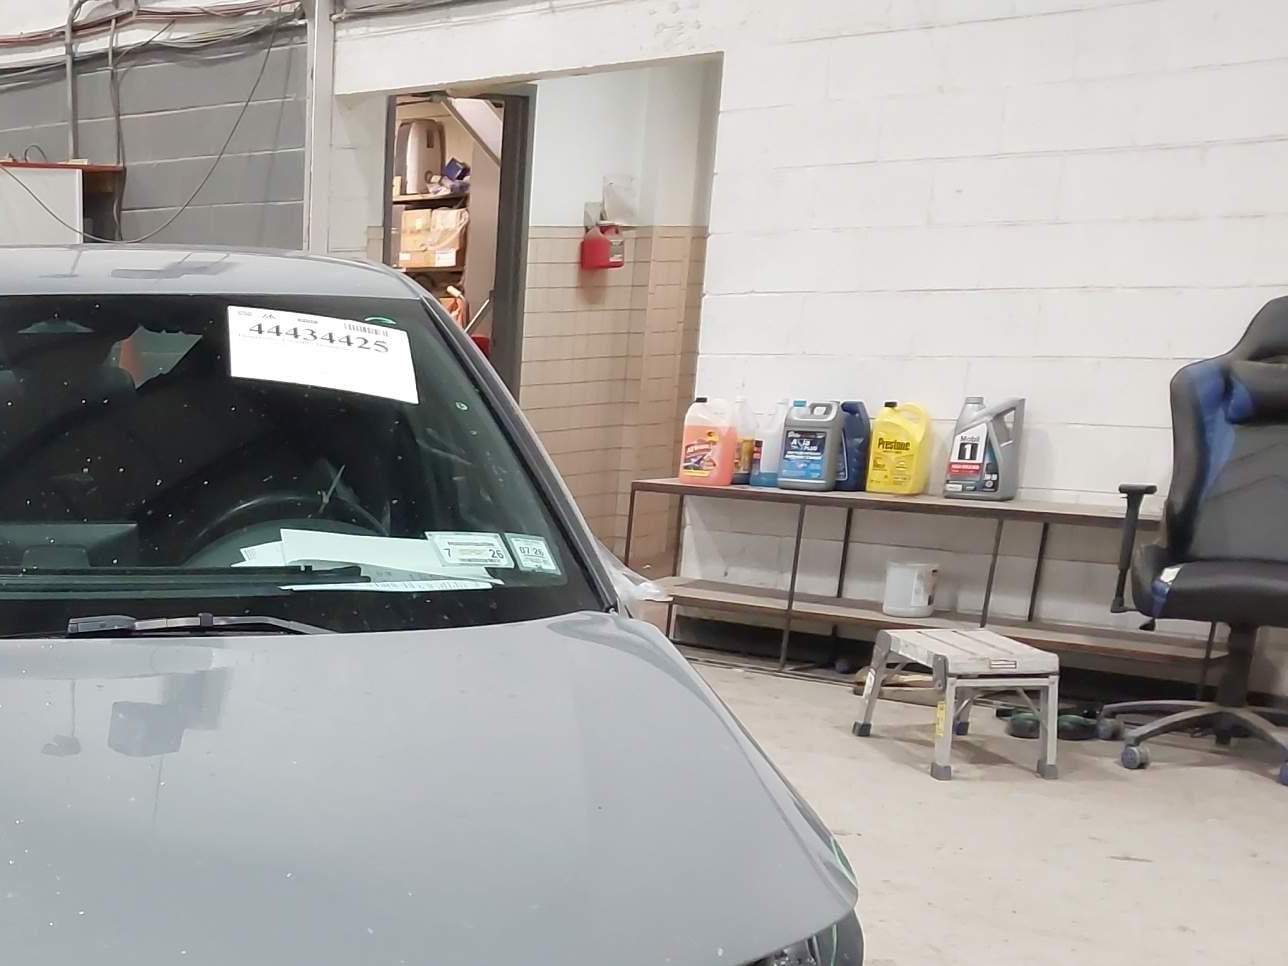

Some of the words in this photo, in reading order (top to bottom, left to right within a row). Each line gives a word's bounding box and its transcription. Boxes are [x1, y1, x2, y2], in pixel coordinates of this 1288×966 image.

[249, 323, 389, 353] 44434425
[878, 437, 910, 450] Prestone
[489, 548, 504, 559] 26
